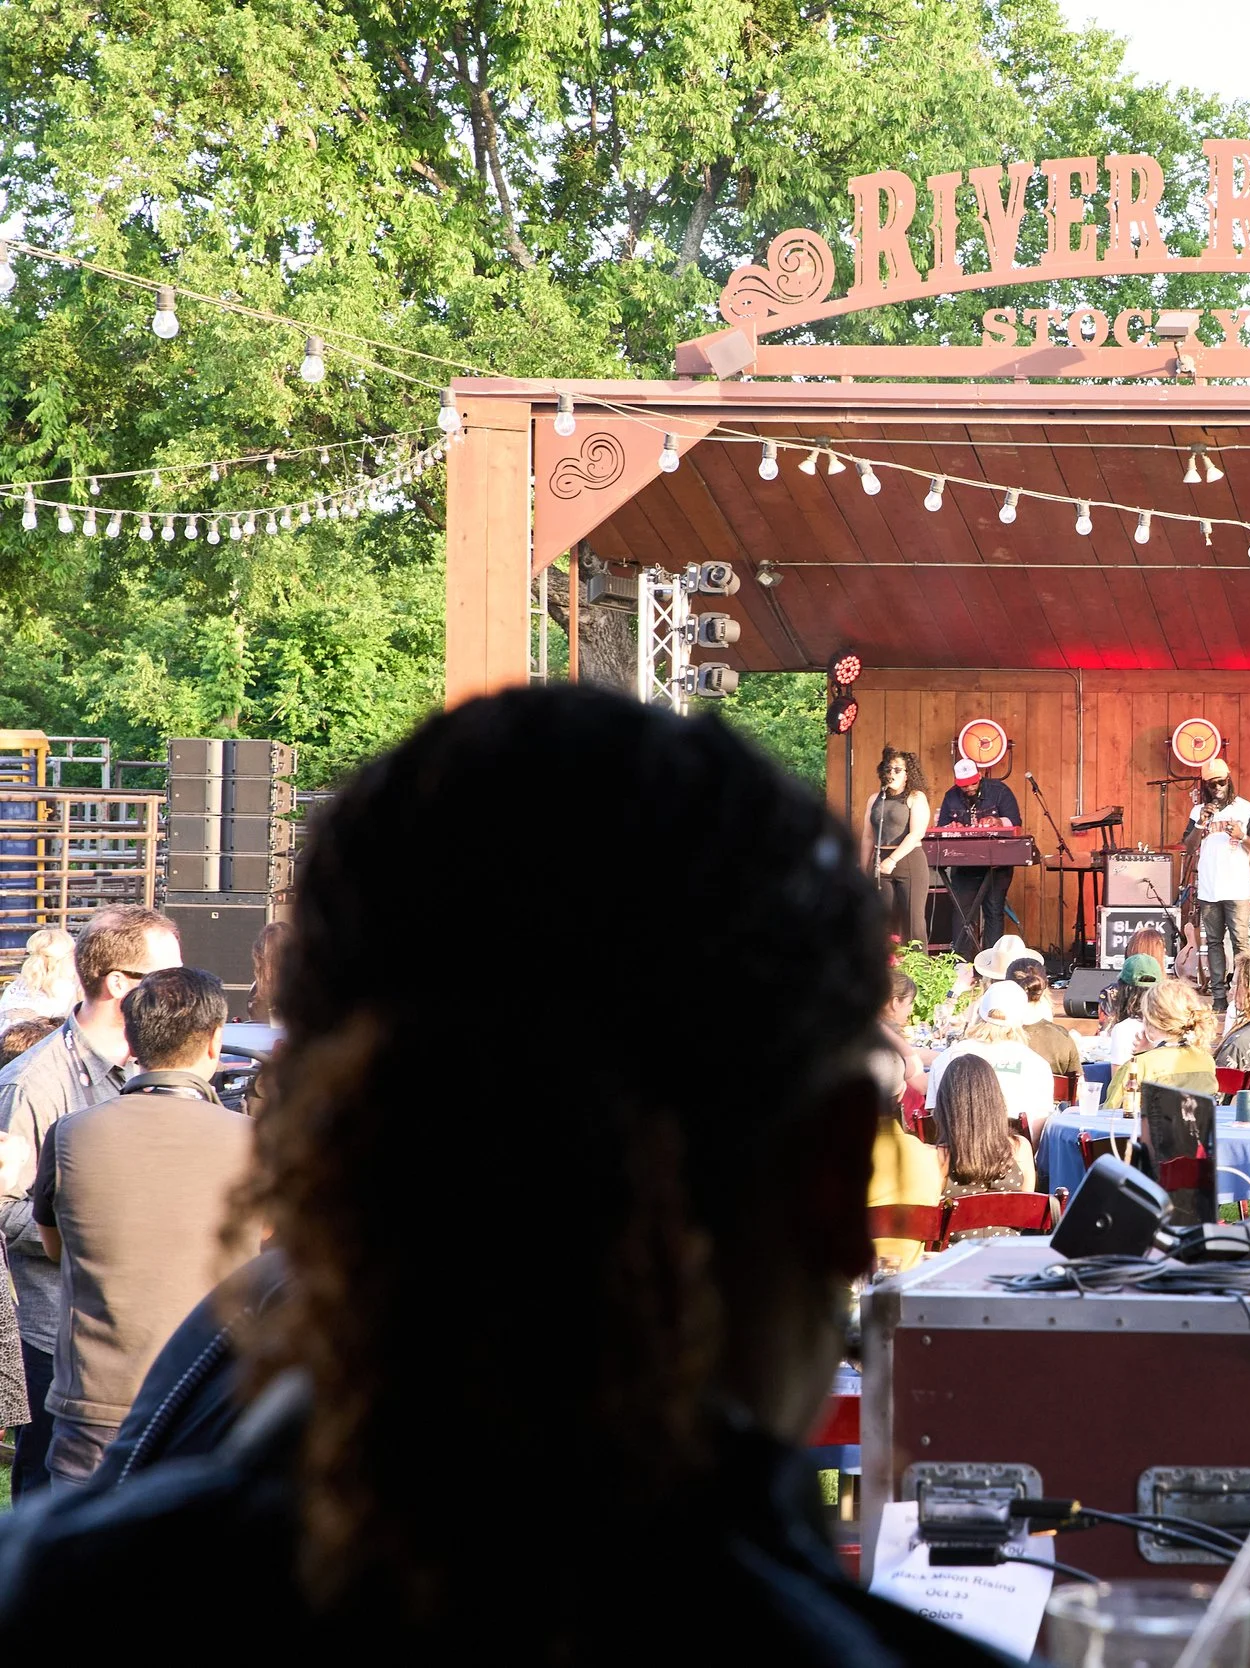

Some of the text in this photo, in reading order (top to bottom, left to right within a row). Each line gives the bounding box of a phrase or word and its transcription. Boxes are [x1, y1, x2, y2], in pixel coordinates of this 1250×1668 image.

[848, 154, 1168, 297] RIVER
[1113, 920, 1166, 934] BLACK
[972, 1576, 1016, 1593] Rising
[918, 1607, 964, 1620] Colors
